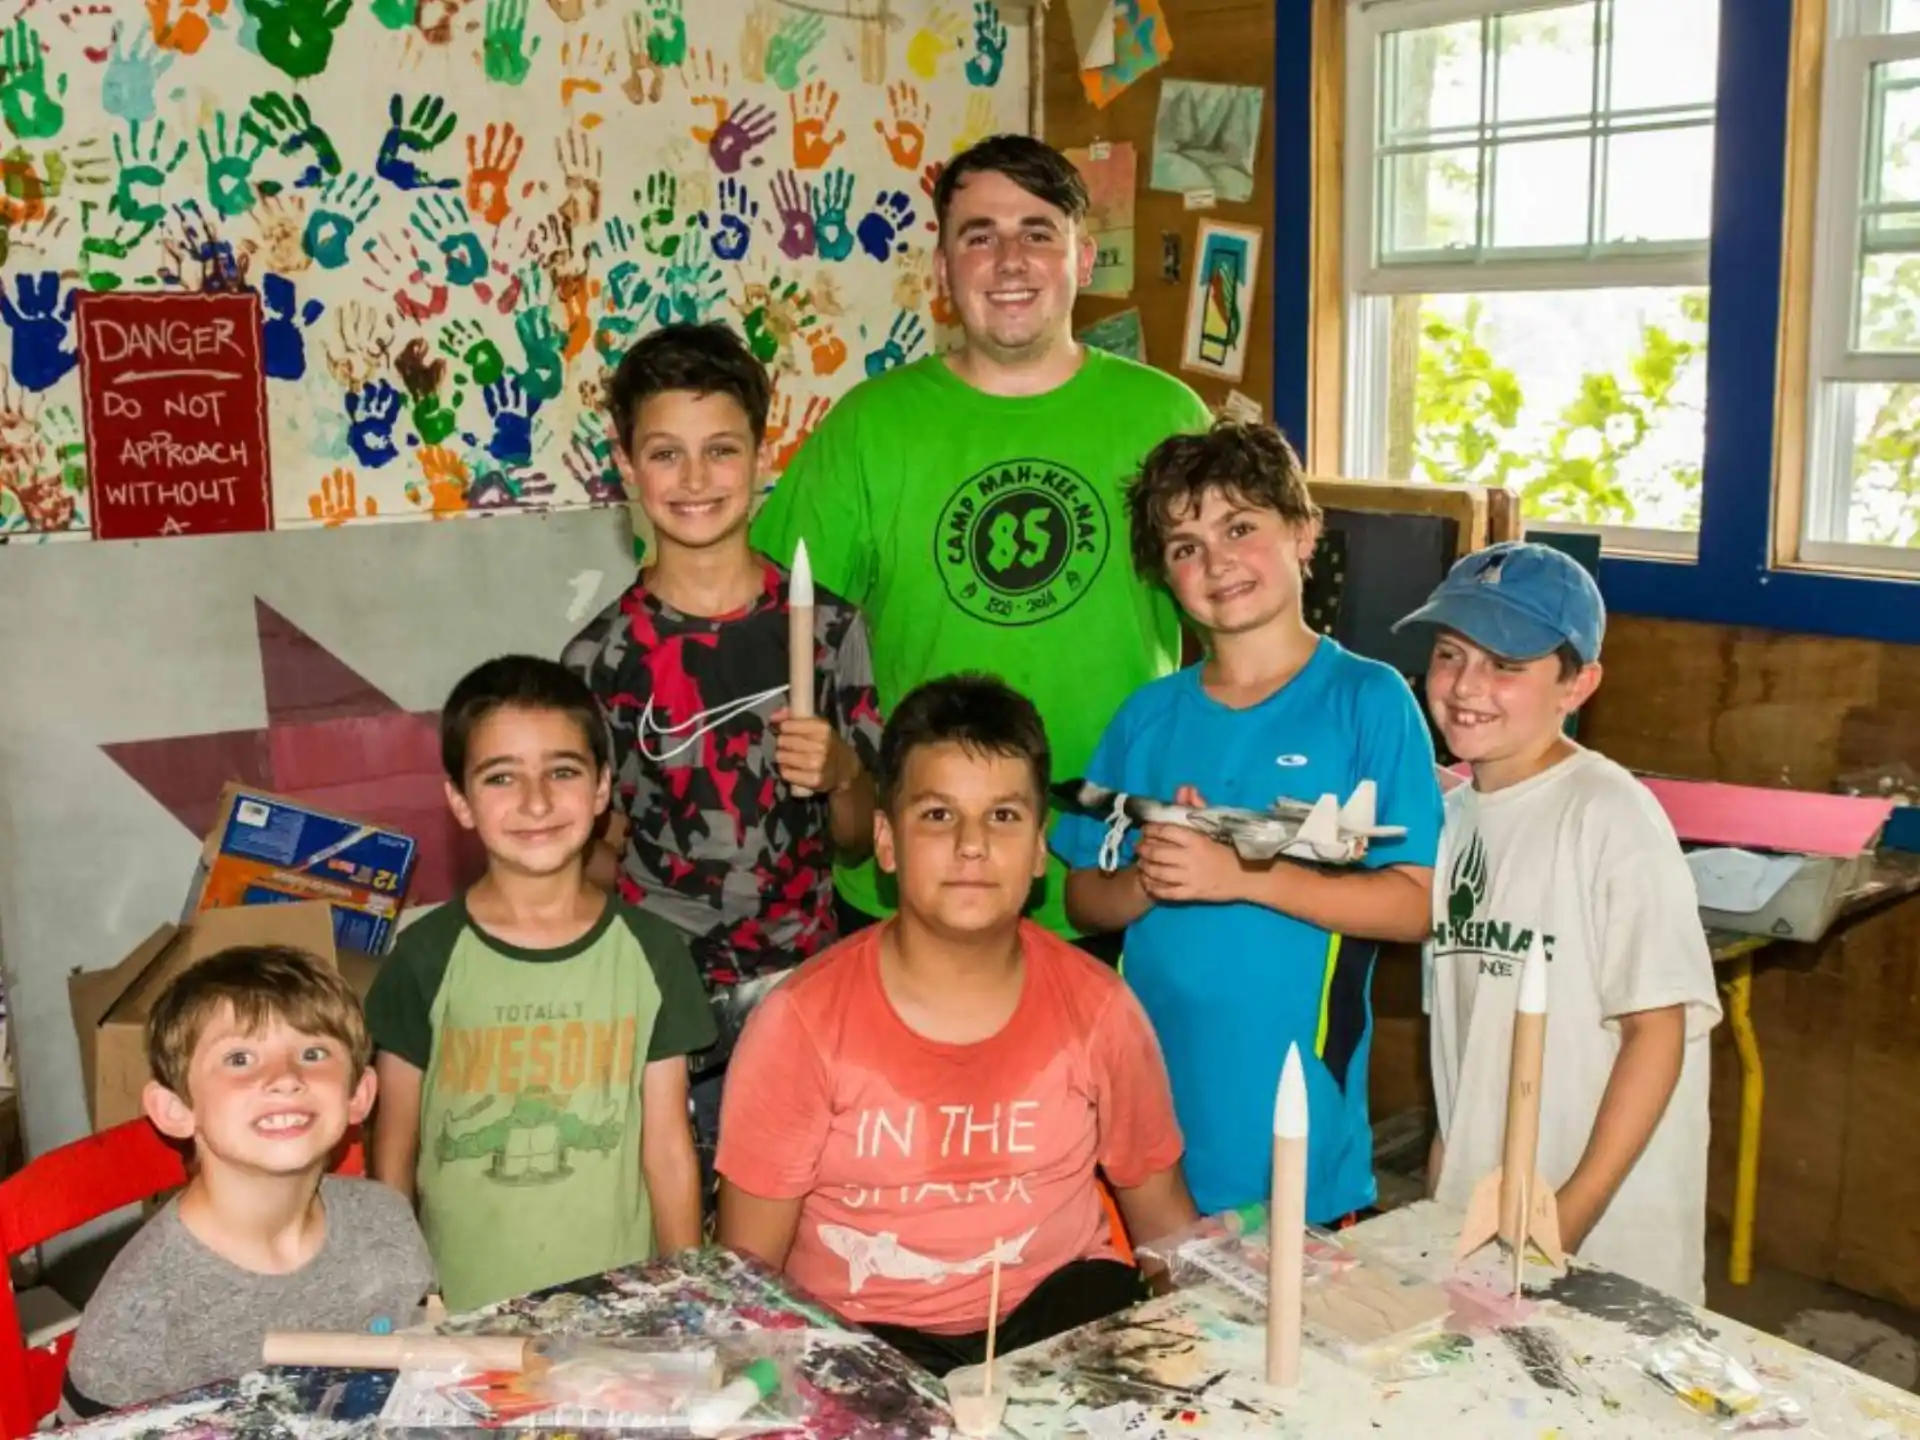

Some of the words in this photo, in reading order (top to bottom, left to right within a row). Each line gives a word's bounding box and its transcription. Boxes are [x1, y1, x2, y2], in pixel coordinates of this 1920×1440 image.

[90, 319, 246, 362] DANGER
[103, 391, 142, 419] DO
[164, 390, 227, 427] NOT
[119, 431, 248, 469] APPROACH
[105, 477, 239, 506] WITHOUT
[947, 497, 974, 565] CAMP
[978, 465, 1096, 553] MAH-KEE-NAC
[987, 508, 1052, 573] 85
[856, 1106, 917, 1158] IN
[939, 1101, 1041, 1158] THE
